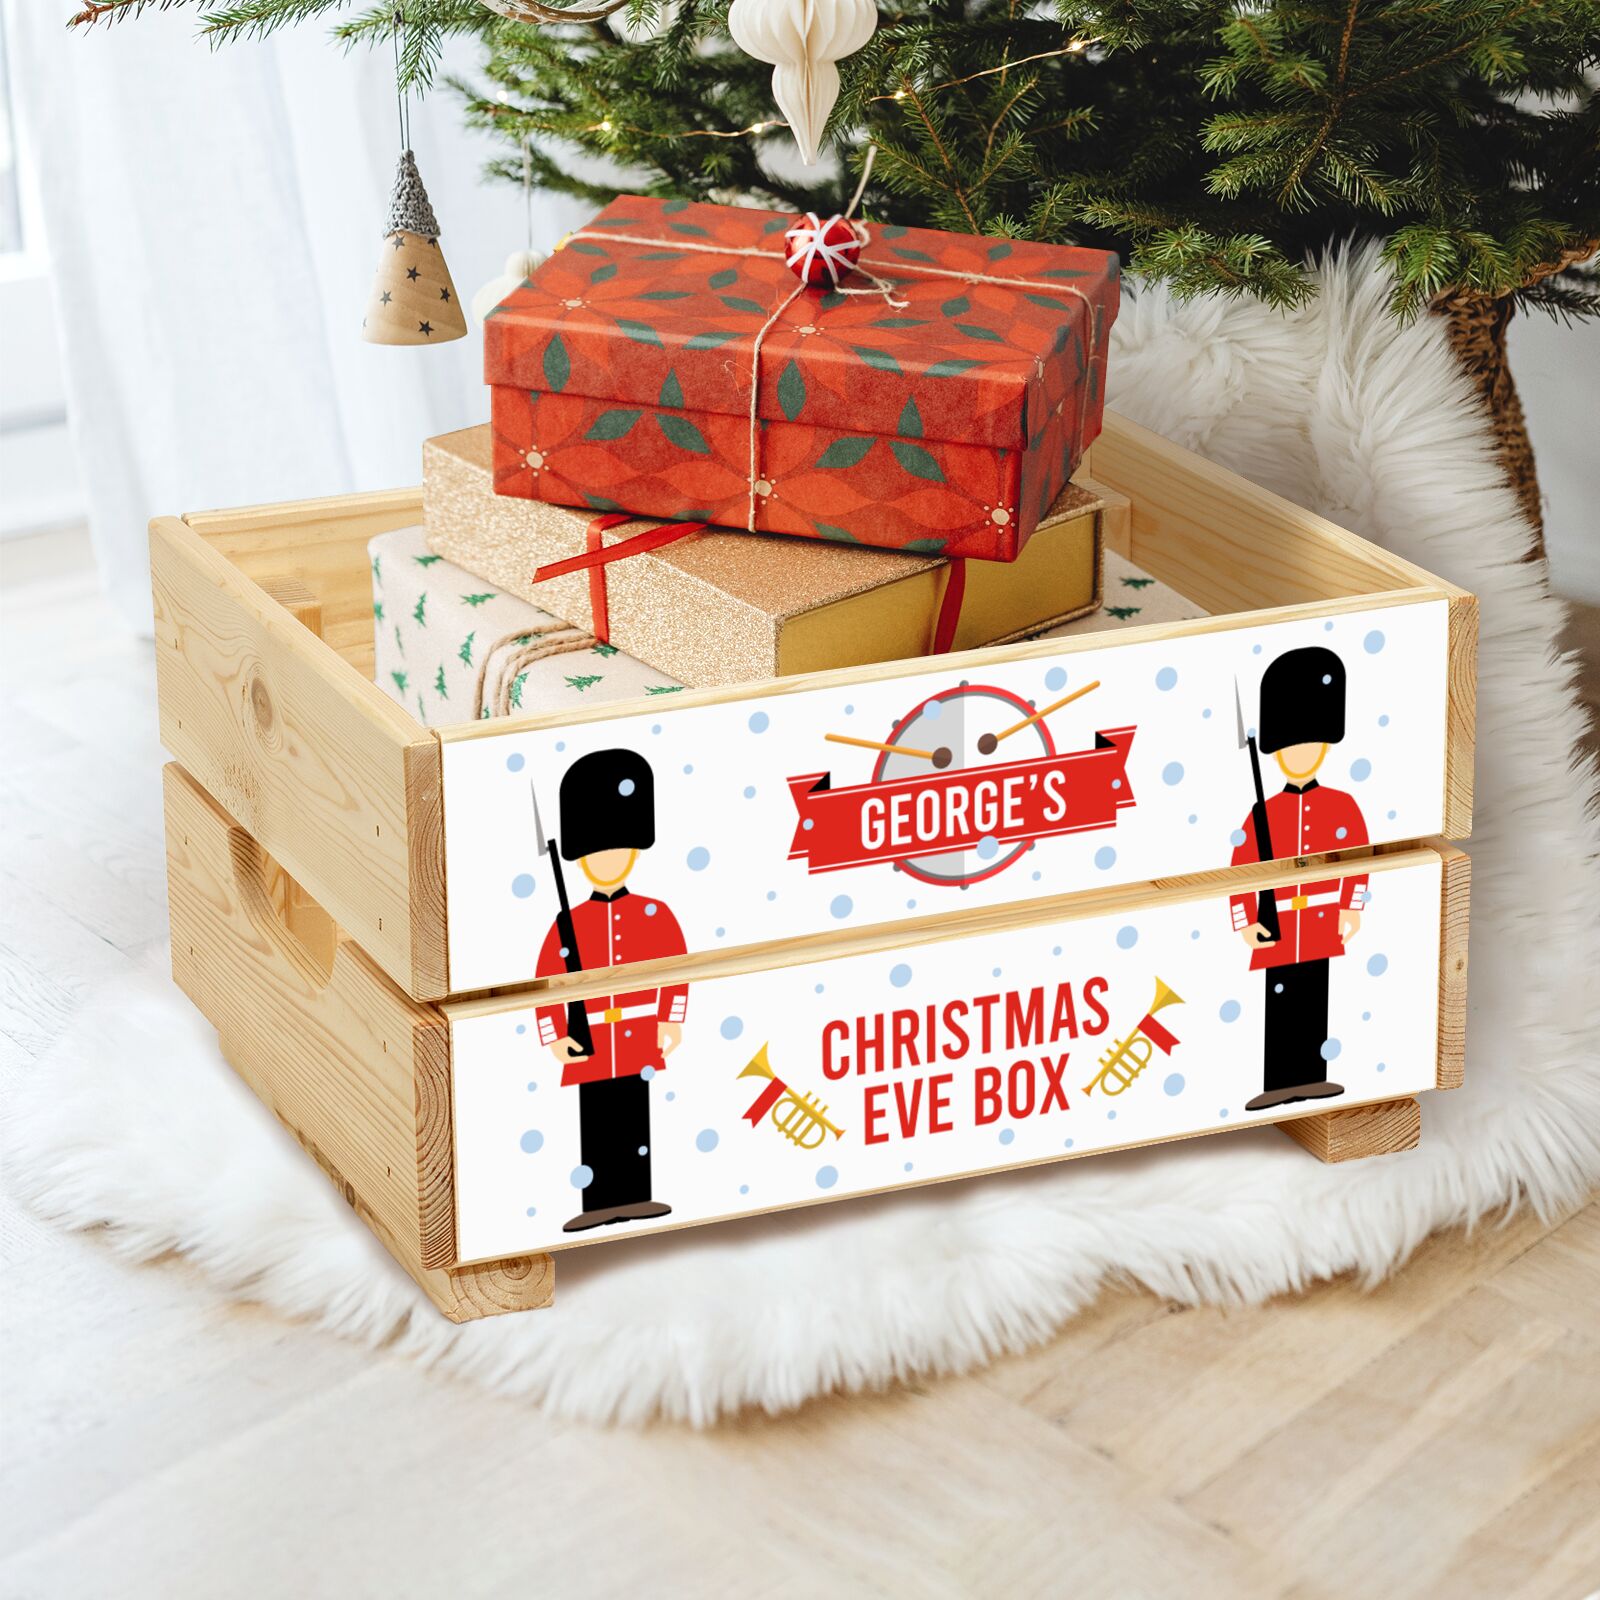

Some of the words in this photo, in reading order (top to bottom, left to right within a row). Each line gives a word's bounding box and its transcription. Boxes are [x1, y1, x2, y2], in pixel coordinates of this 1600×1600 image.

[861, 770, 1066, 850] GEORGE'S
[822, 976, 1110, 1081] CHRISTMAS
[864, 1073, 953, 1146] EVE
[974, 1053, 1070, 1126] BOX
